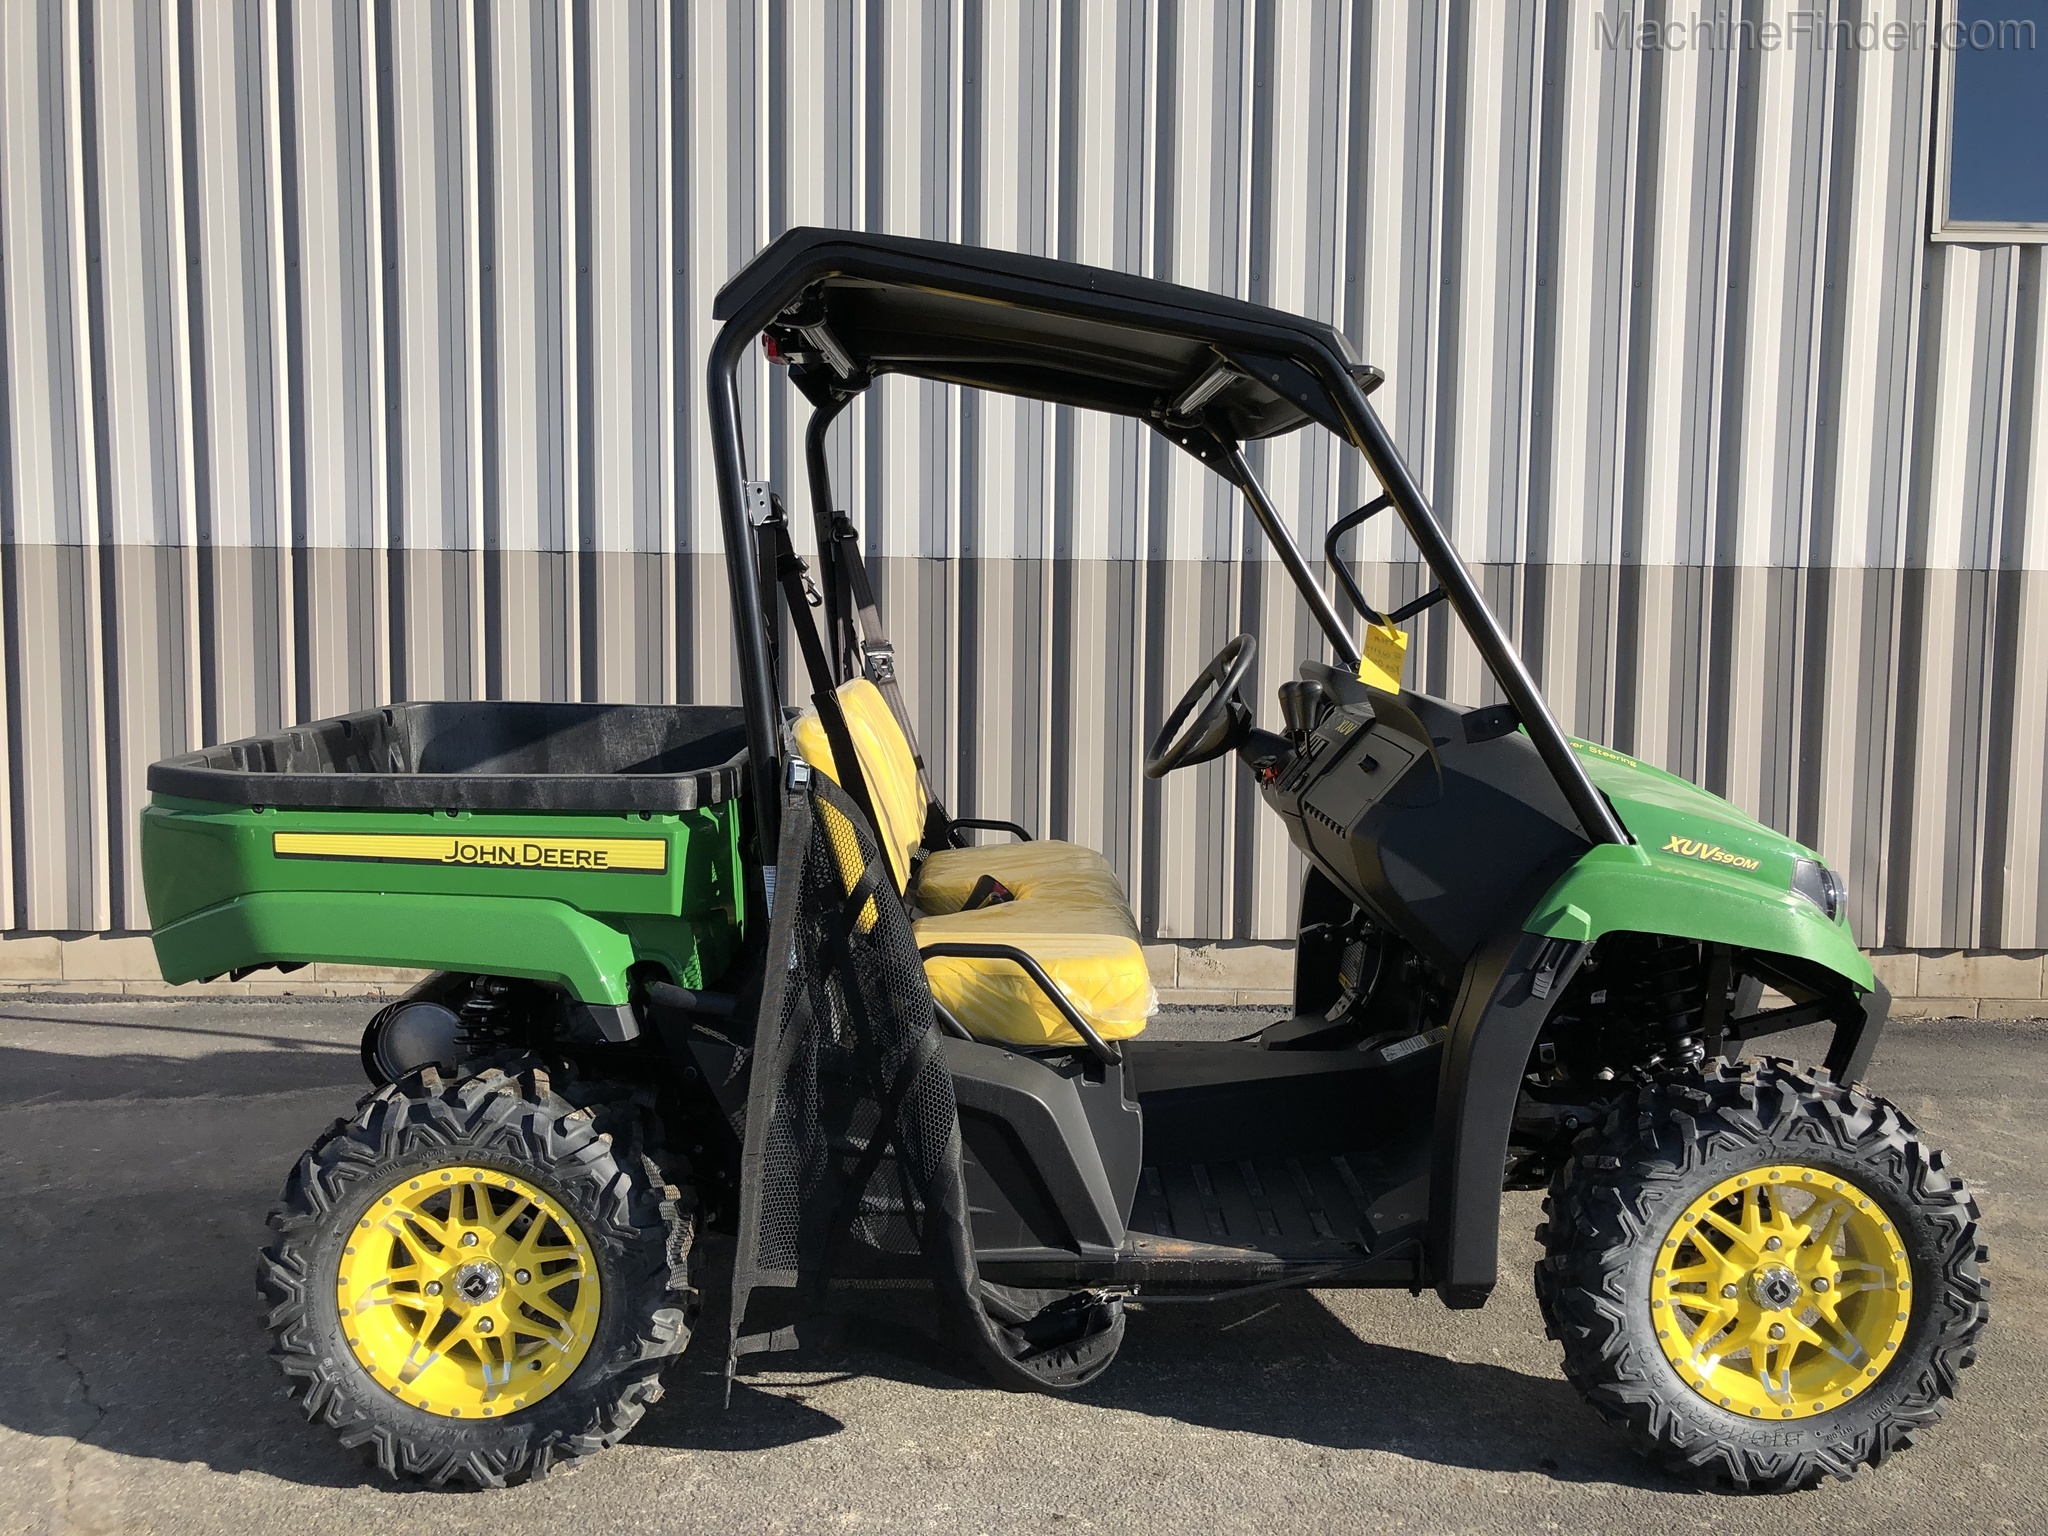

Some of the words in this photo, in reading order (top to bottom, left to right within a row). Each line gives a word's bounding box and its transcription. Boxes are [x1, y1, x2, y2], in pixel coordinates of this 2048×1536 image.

[1335, 720, 1358, 735] XUV
[1589, 746, 1637, 768] Steering
[445, 841, 515, 863] JOHN
[523, 844, 608, 867] DEERE
